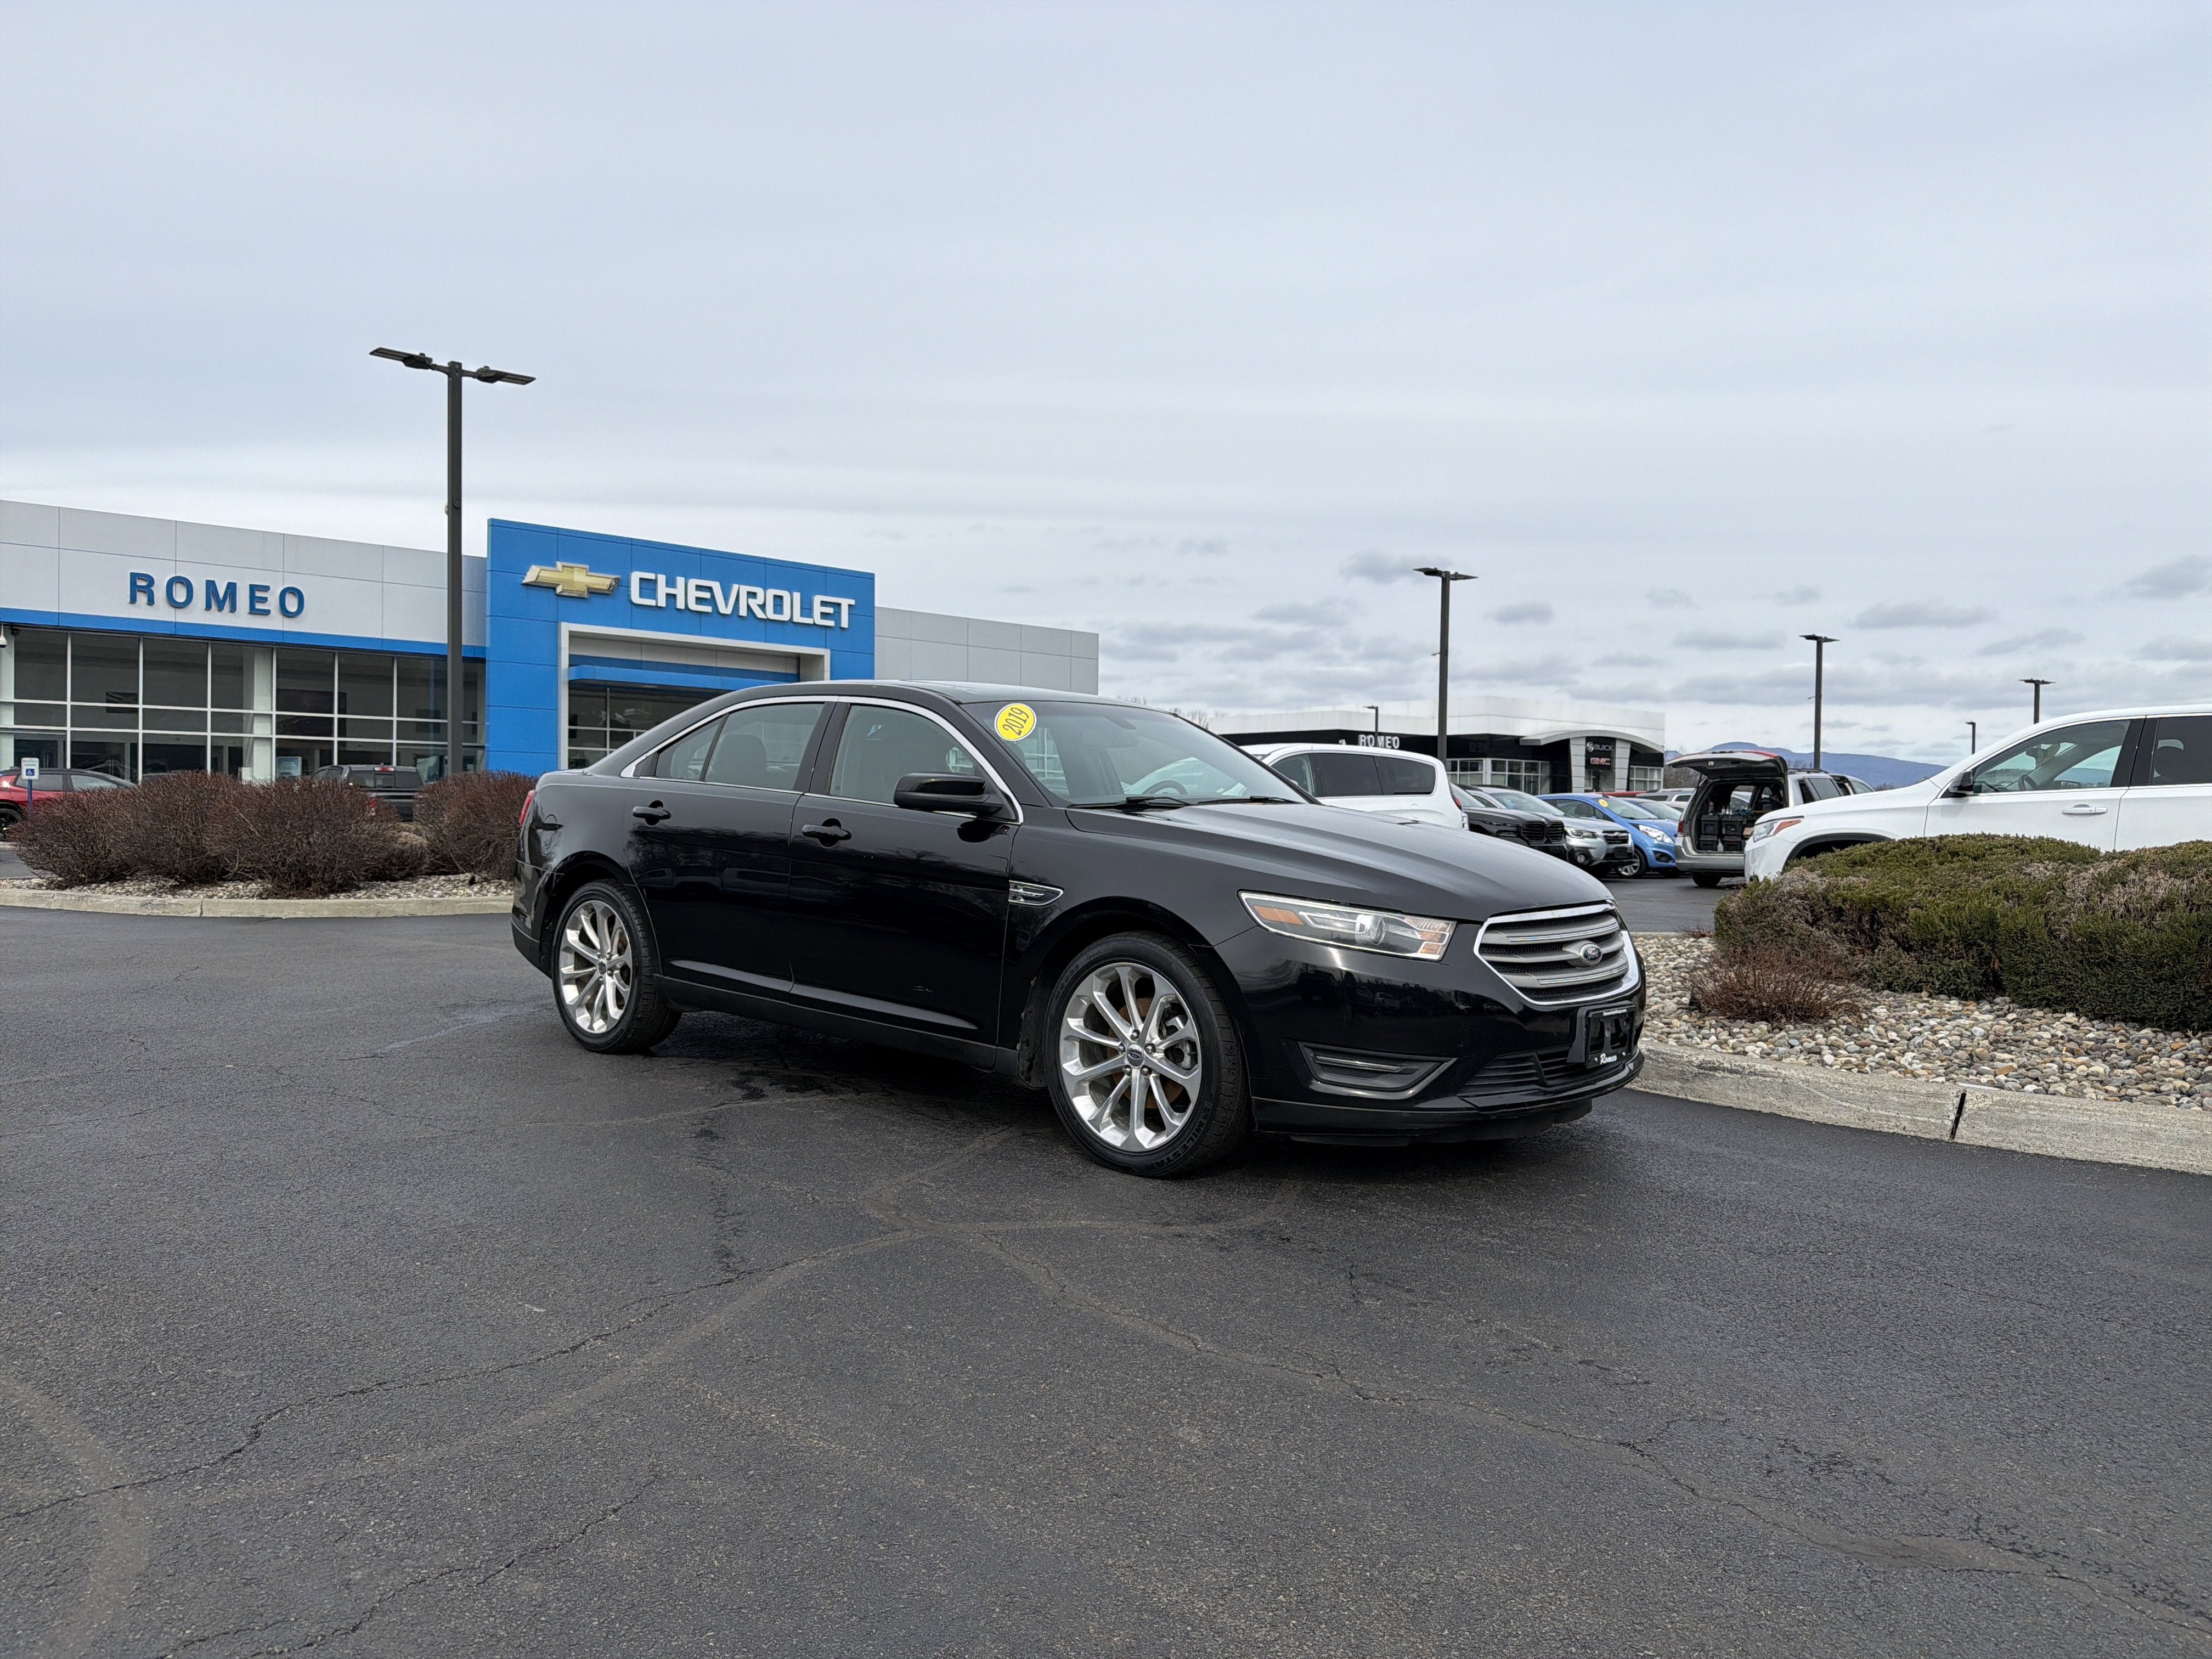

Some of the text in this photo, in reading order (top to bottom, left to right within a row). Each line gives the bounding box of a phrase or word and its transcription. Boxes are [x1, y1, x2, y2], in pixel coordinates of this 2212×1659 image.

[129, 572, 305, 618] ROMEO
[630, 571, 855, 629] CHEVROLET
[1003, 708, 1029, 736] 2019
[1358, 734, 1400, 749] ROMEO
